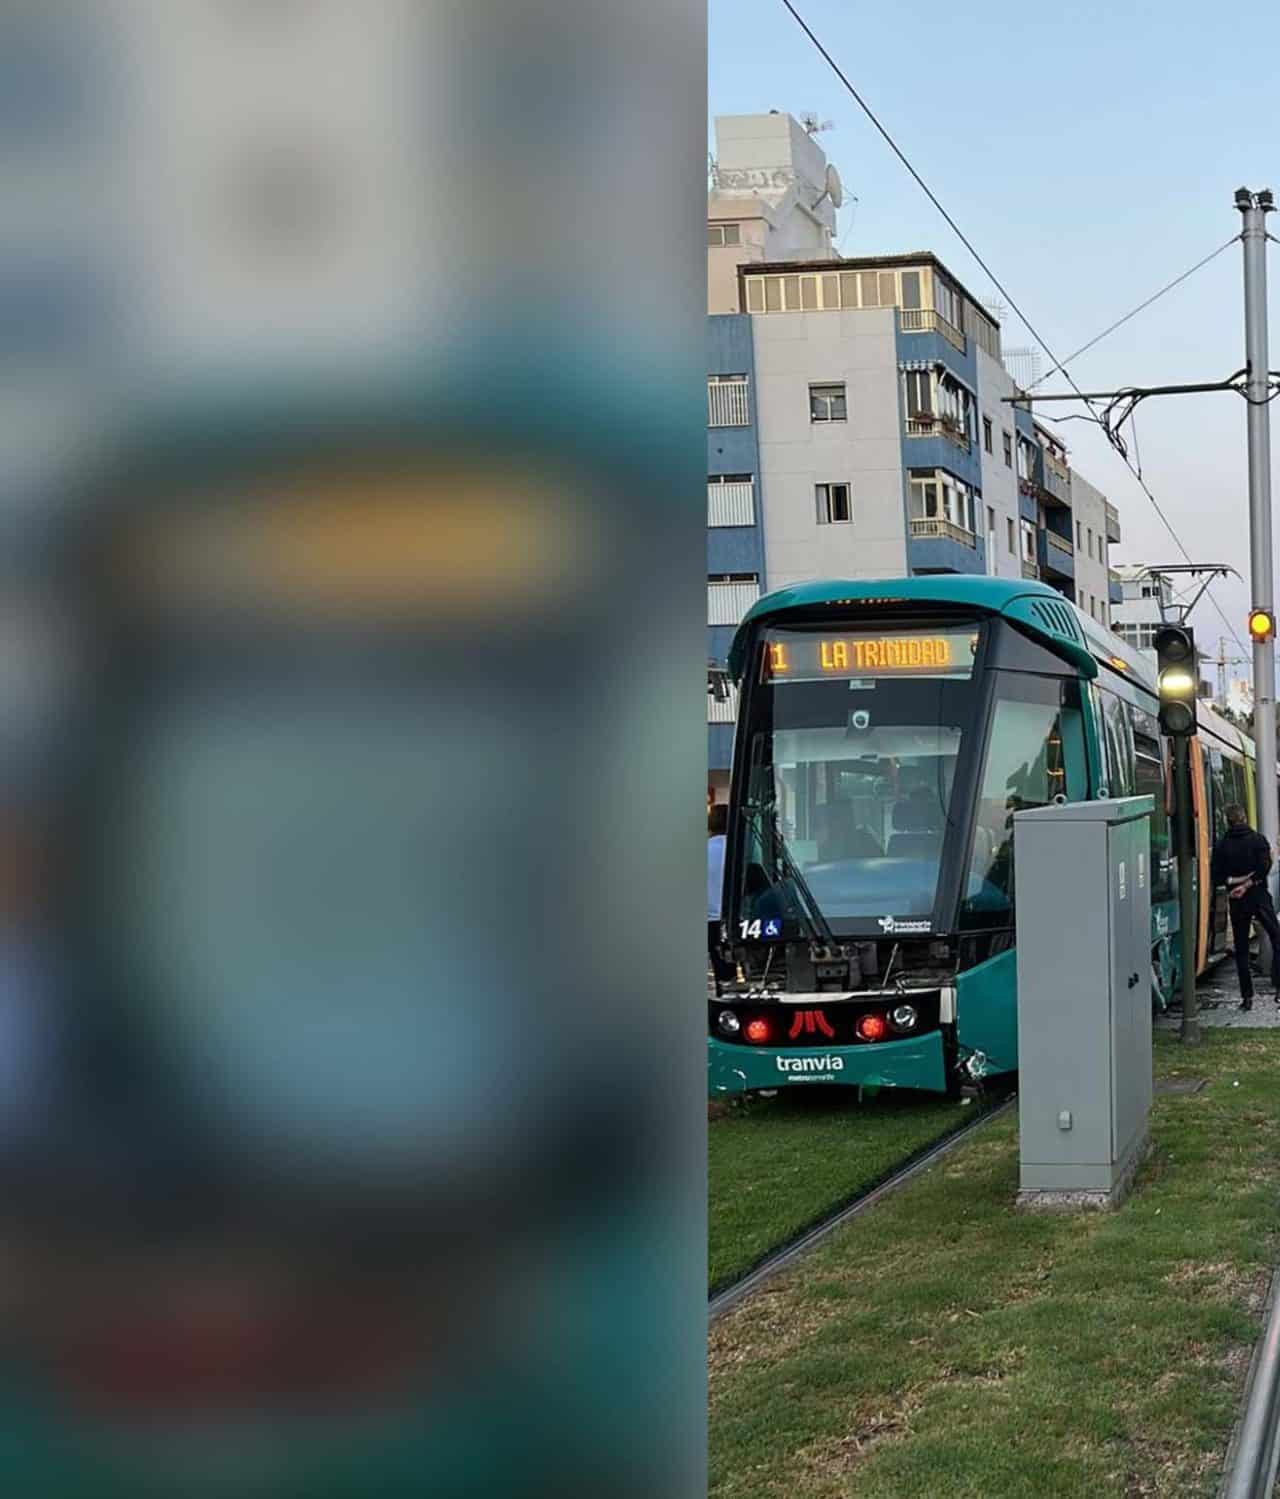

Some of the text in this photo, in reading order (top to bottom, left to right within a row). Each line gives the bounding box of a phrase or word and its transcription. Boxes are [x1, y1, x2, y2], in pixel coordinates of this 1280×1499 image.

[821, 639, 848, 669] LA
[853, 638, 950, 668] TRINIDAD
[738, 918, 762, 939] 14
